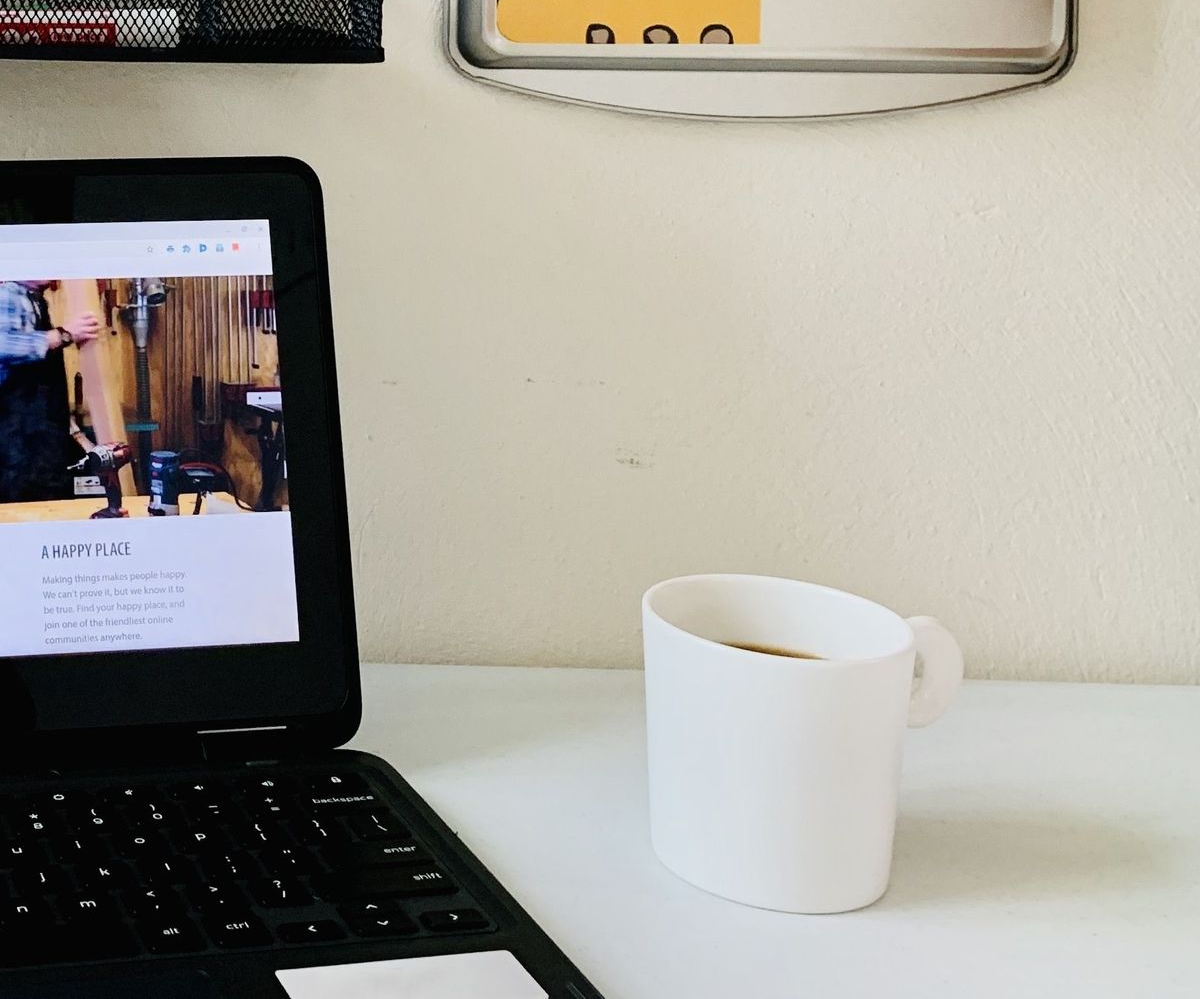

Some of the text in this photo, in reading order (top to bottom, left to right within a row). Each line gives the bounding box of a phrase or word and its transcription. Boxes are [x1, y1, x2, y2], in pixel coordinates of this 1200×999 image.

[42, 542, 131, 559] A HAPPY PLACE
[44, 616, 174, 632] join one of the friendliest online
[45, 633, 143, 645] communities anywhere.
[311, 795, 374, 804] backspace
[383, 846, 416, 854] enter
[412, 872, 443, 881] shift
[225, 921, 250, 930] ctrl
[162, 927, 180, 936] alt
